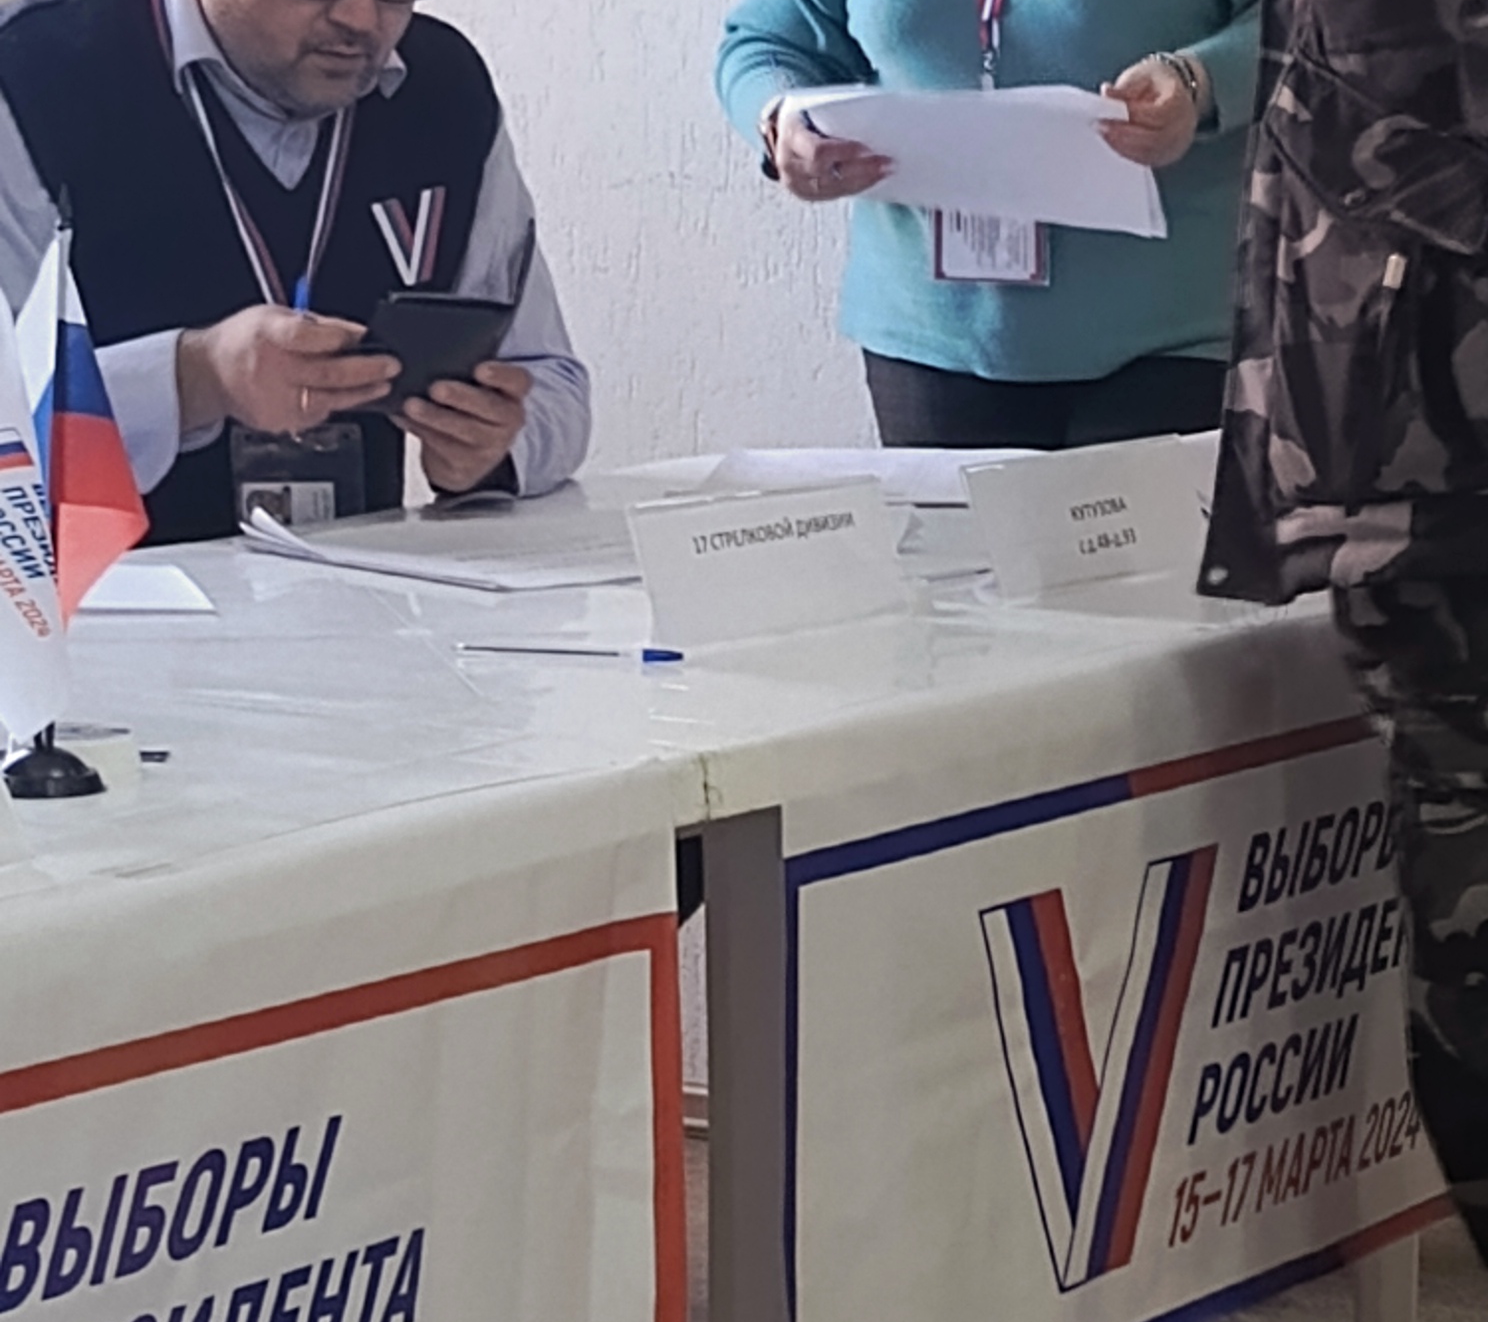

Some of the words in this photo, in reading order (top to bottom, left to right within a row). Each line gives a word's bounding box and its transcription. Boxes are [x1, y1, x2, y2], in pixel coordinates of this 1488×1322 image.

[1187, 1013, 1359, 1146] РОССИИ
[0, 1115, 342, 1314] ВЫБОРЫ
[1255, 1114, 1355, 1213] МАРТА
[1356, 1089, 1423, 1173] 2024
